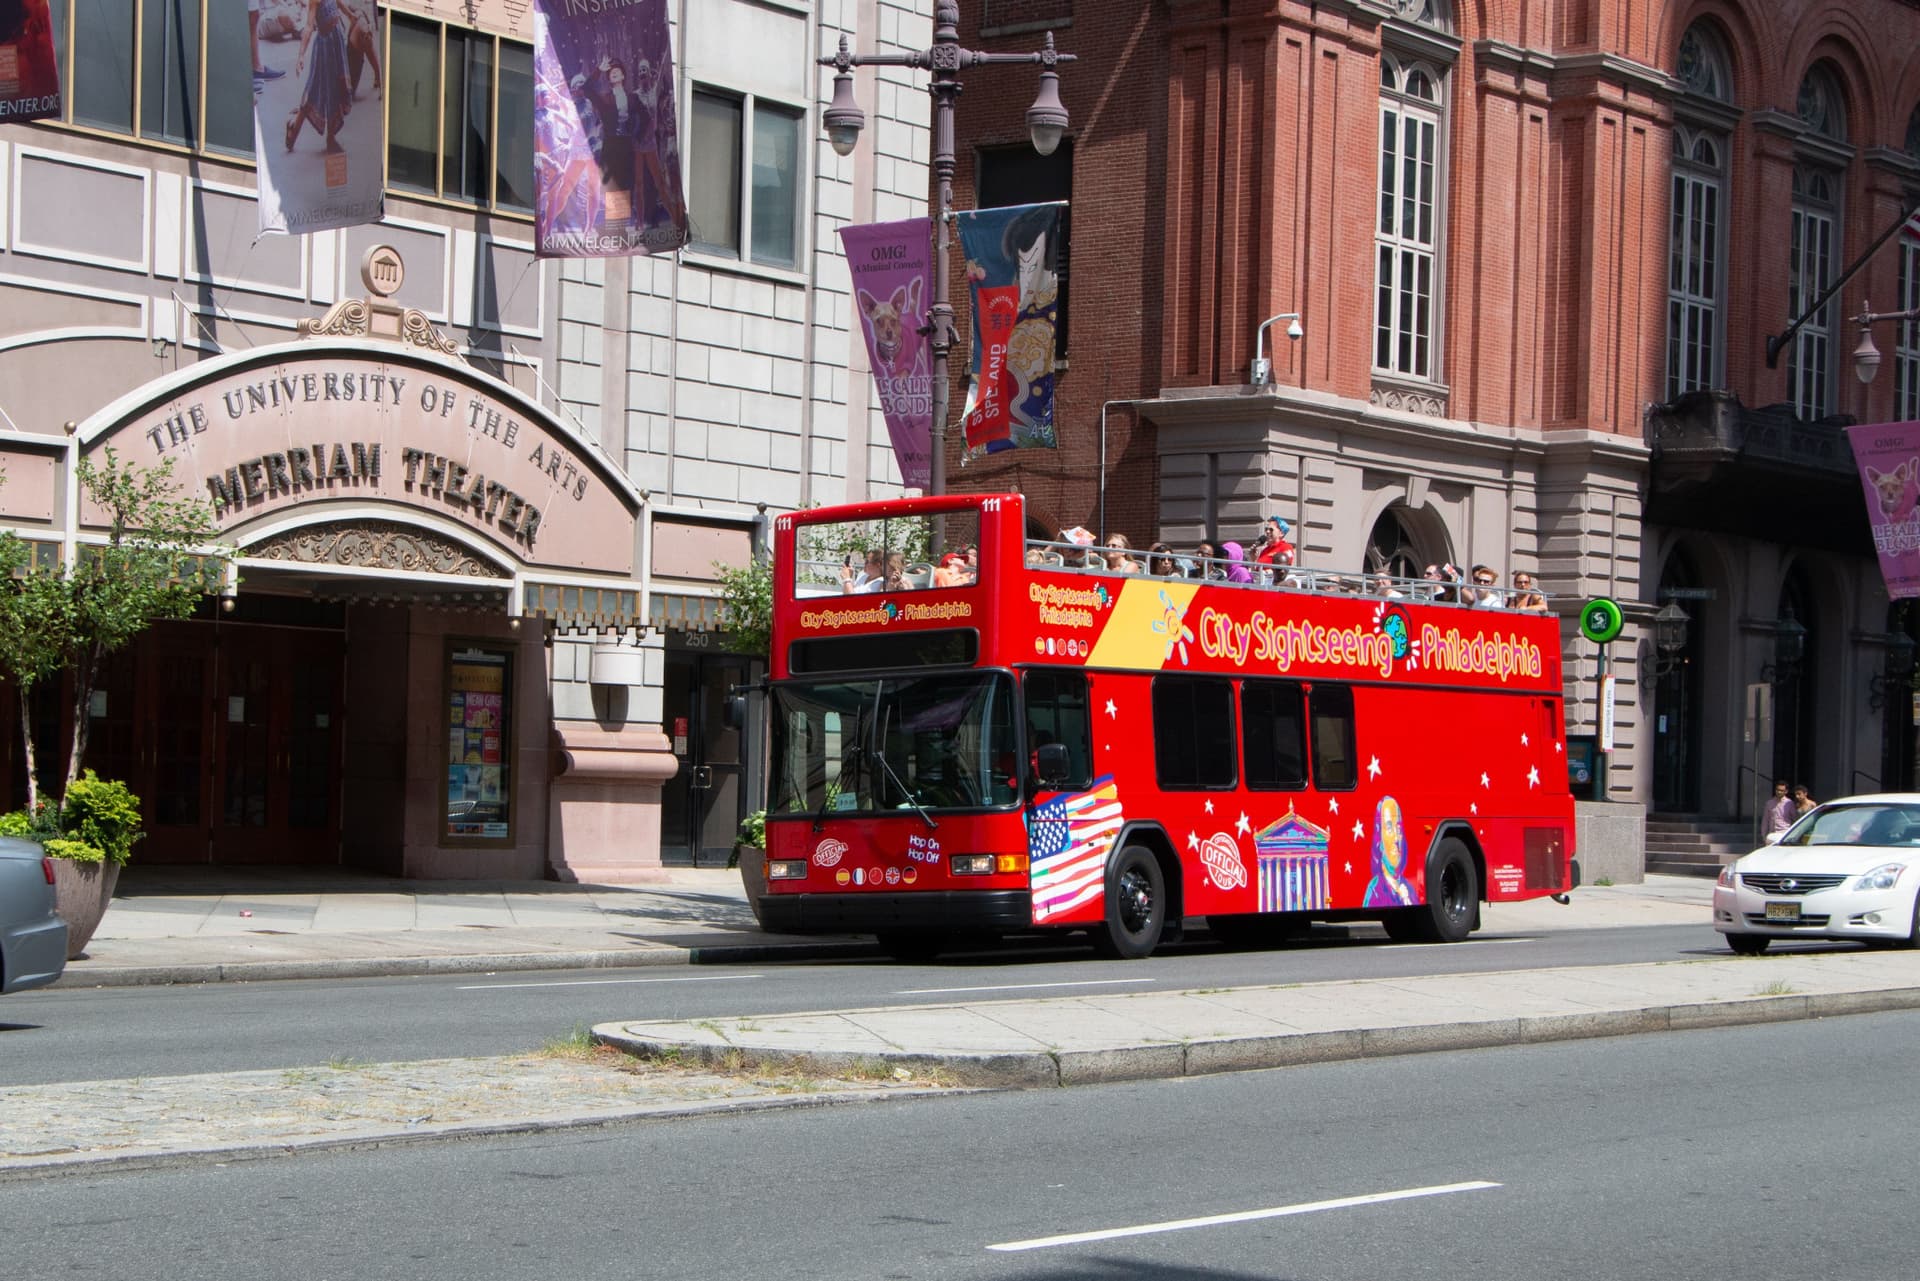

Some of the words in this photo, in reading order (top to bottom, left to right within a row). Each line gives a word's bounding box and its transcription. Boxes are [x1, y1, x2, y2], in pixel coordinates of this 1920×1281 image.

[871, 245, 906, 261] OMG!
[146, 402, 209, 455] THE
[223, 372, 406, 419] UNIVERSITY
[420, 385, 457, 418] OF
[469, 398, 520, 449] THE
[528, 441, 588, 501] ARTS
[206, 442, 381, 519] MERRIAM
[402, 446, 543, 545] THEATER
[981, 498, 1001, 512] 111
[777, 516, 792, 531] 111
[904, 601, 972, 622] Philadelphia
[1040, 605, 1094, 629] Philadelphia
[686, 632, 708, 647] 250
[1421, 622, 1542, 682] Philadelphia
[909, 834, 926, 849] Hop
[927, 838, 940, 850] On
[816, 844, 845, 862] OFFICIAL
[908, 848, 924, 862] Hop
[925, 850, 940, 864] Off
[1206, 846, 1243, 881] OFFICIAL
[1214, 870, 1233, 887] TOUR
